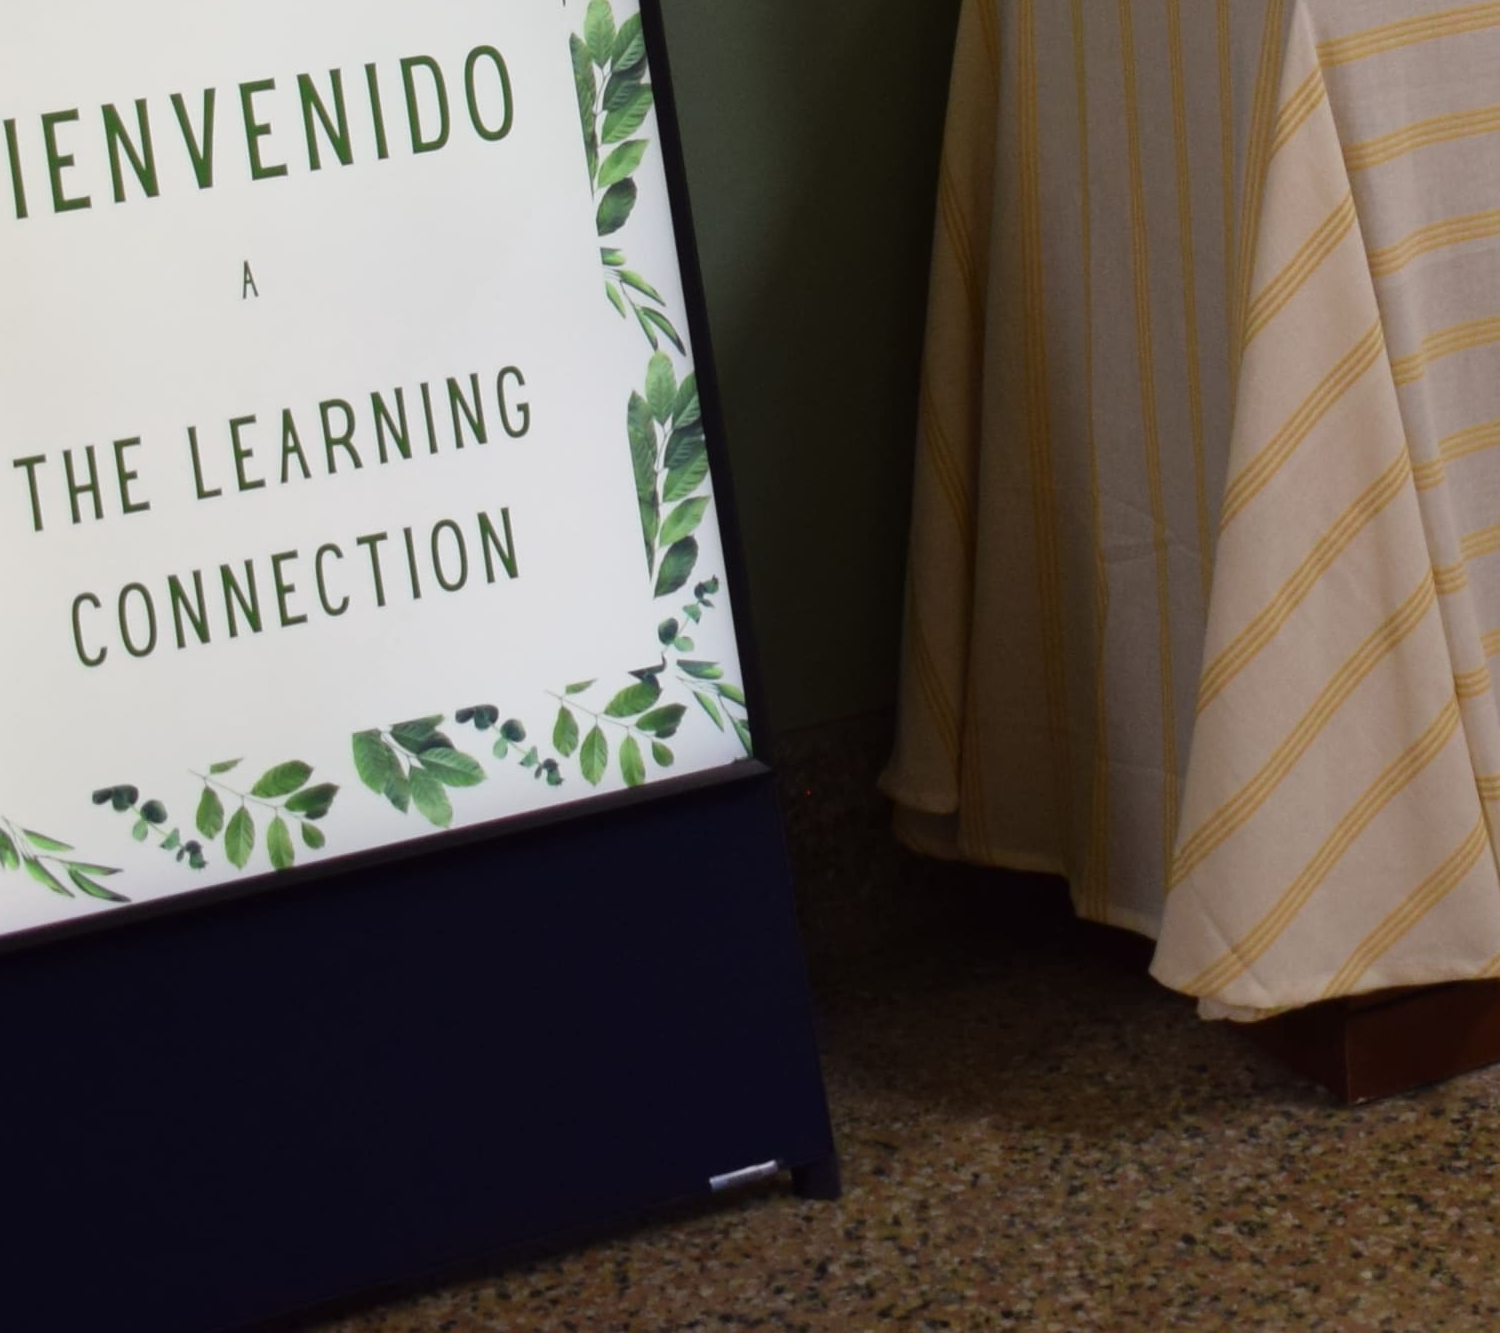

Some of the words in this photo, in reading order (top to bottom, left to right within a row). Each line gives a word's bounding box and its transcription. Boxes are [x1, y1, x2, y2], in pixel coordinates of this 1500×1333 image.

[241, 260, 259, 300] A
[12, 435, 151, 532] THE
[187, 365, 531, 500] LEARNING
[71, 507, 519, 667] CONNECTION
